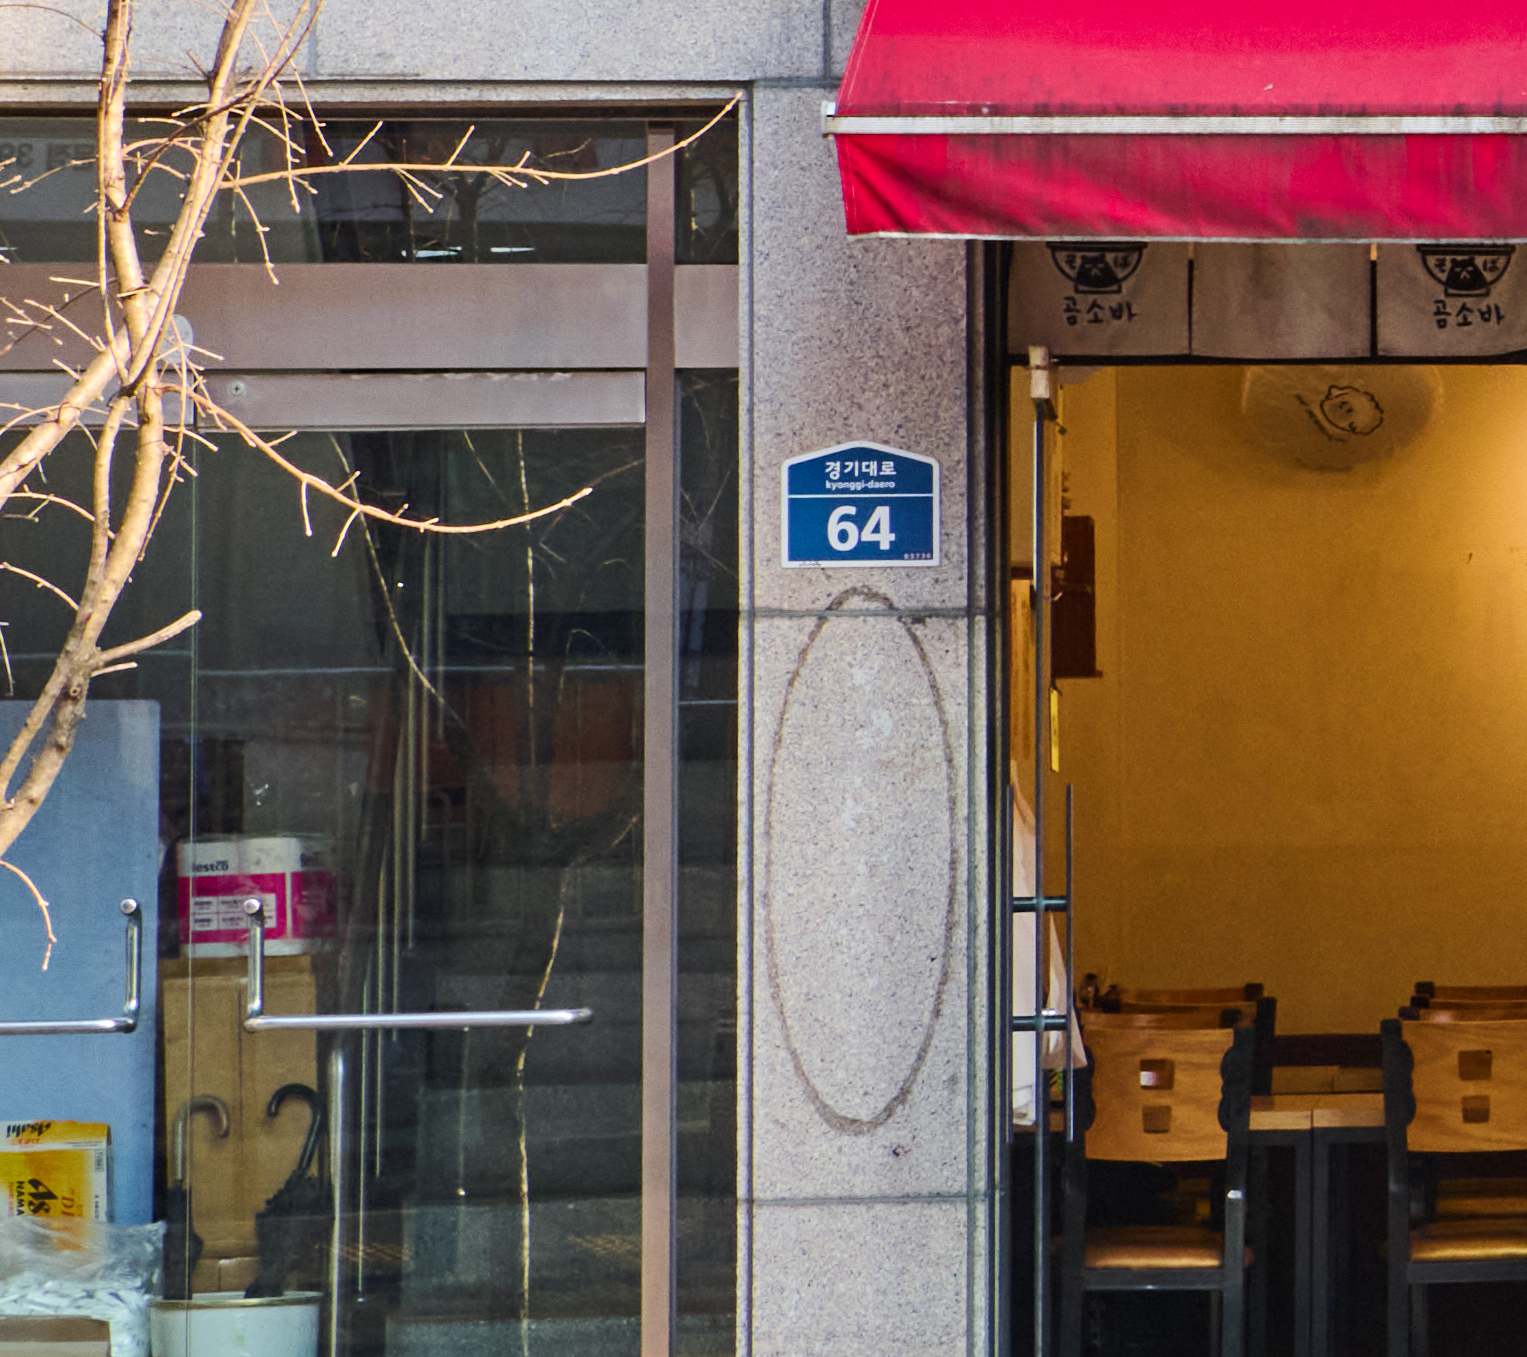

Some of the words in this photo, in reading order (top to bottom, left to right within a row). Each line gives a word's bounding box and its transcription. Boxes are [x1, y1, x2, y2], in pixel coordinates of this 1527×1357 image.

[1062, 296, 1138, 325] 곰소바
[1433, 300, 1504, 328] 곰소바
[825, 460, 897, 480] 경기대로
[827, 505, 896, 552] 64
